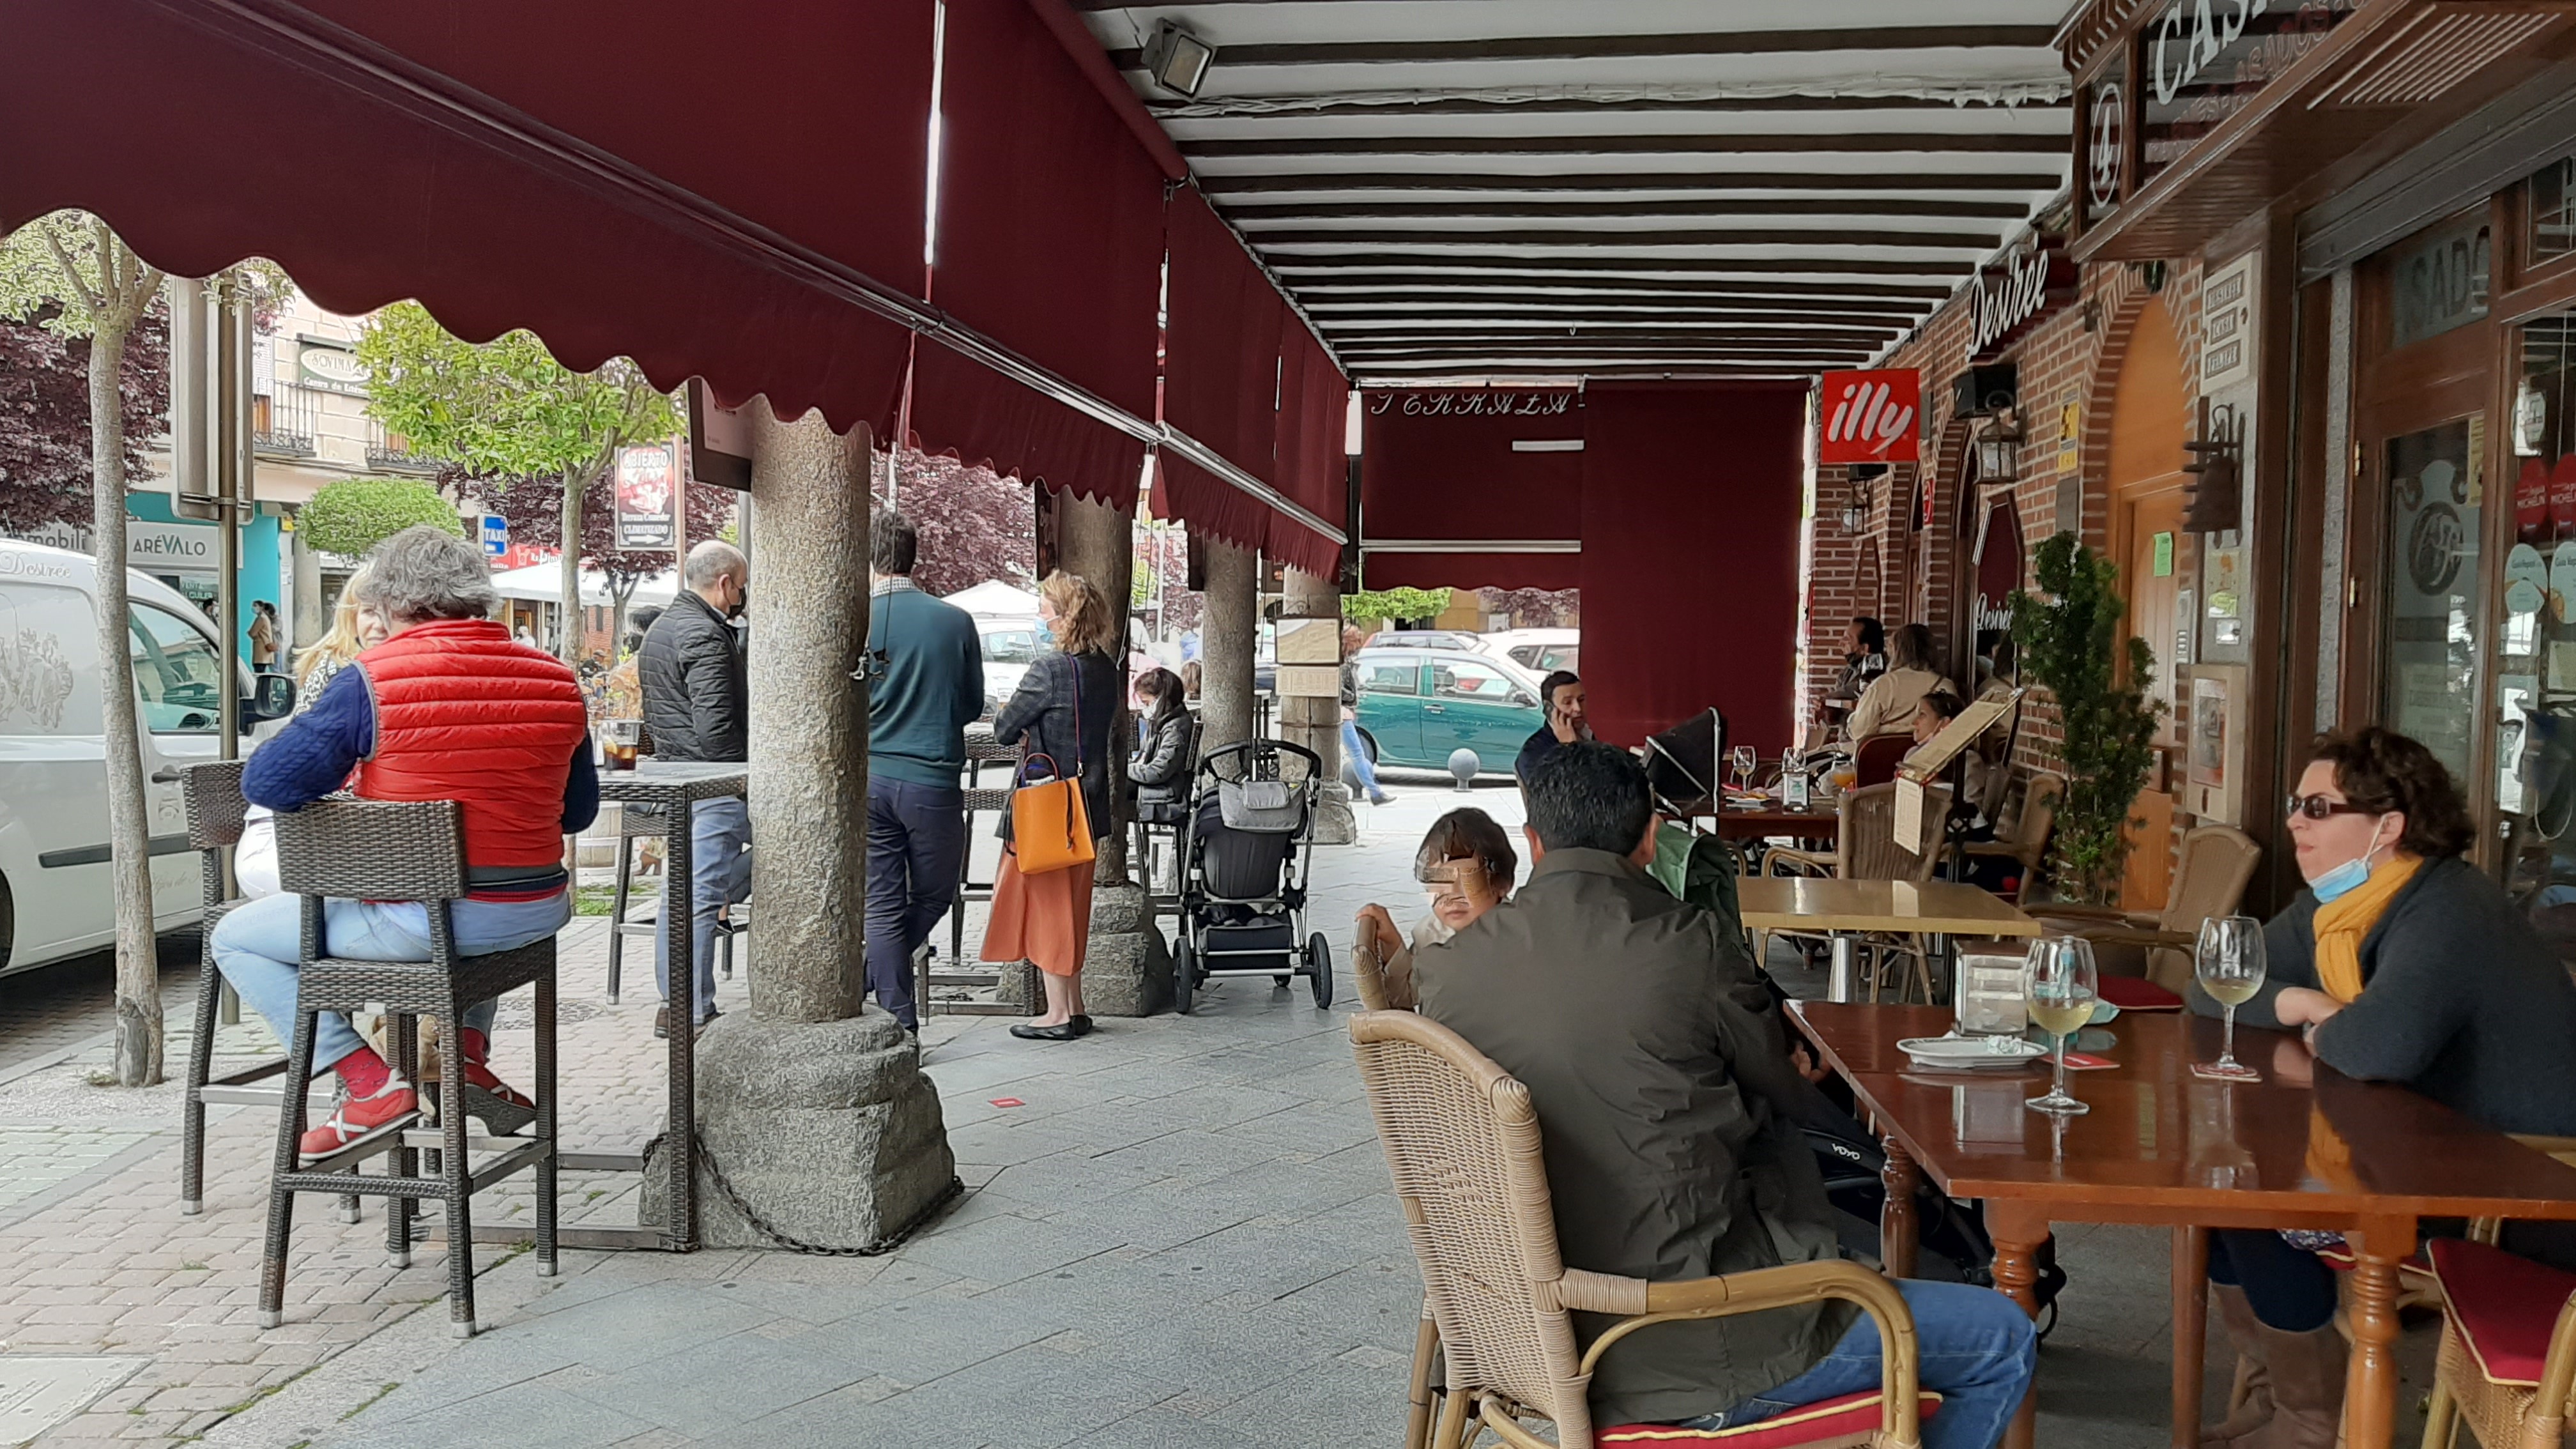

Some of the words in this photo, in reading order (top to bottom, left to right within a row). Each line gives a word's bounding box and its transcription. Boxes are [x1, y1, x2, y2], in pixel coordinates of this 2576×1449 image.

[1828, 381, 1913, 454] illy
[624, 451, 668, 468] ABIERTO
[6, 529, 86, 550] mobili
[133, 533, 206, 556] ARÉVALO
[484, 528, 505, 542] TAXI
